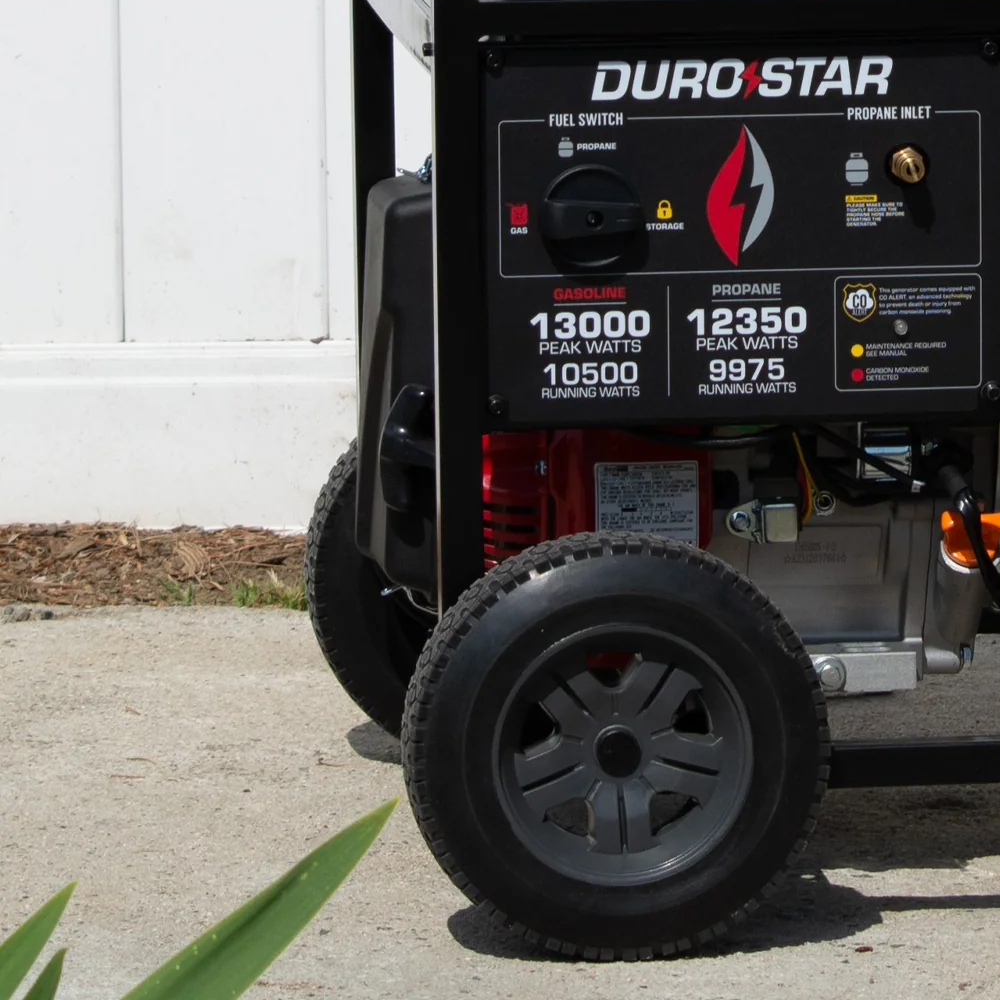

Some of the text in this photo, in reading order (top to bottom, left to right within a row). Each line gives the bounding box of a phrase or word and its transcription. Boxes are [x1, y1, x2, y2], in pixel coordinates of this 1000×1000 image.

[549, 113, 623, 126] FUEL SWITCH
[847, 106, 931, 121] PROPANE INLET
[577, 143, 616, 151] PROPANE
[510, 227, 527, 235] GAS
[646, 223, 684, 231] STORAGE
[554, 287, 626, 300] GASOLINE
[712, 283, 781, 296] PROPANE
[853, 294, 867, 308] CO
[530, 310, 650, 339] 13000
[687, 306, 807, 335] 12350
[540, 340, 641, 355] PEAK WATTS
[696, 336, 798, 351] PEAK WATTS
[543, 362, 637, 385] 10500
[710, 358, 784, 381] 9975
[542, 386, 640, 399] RUNNING WATTS
[699, 382, 796, 395] RUNNING WATTS
